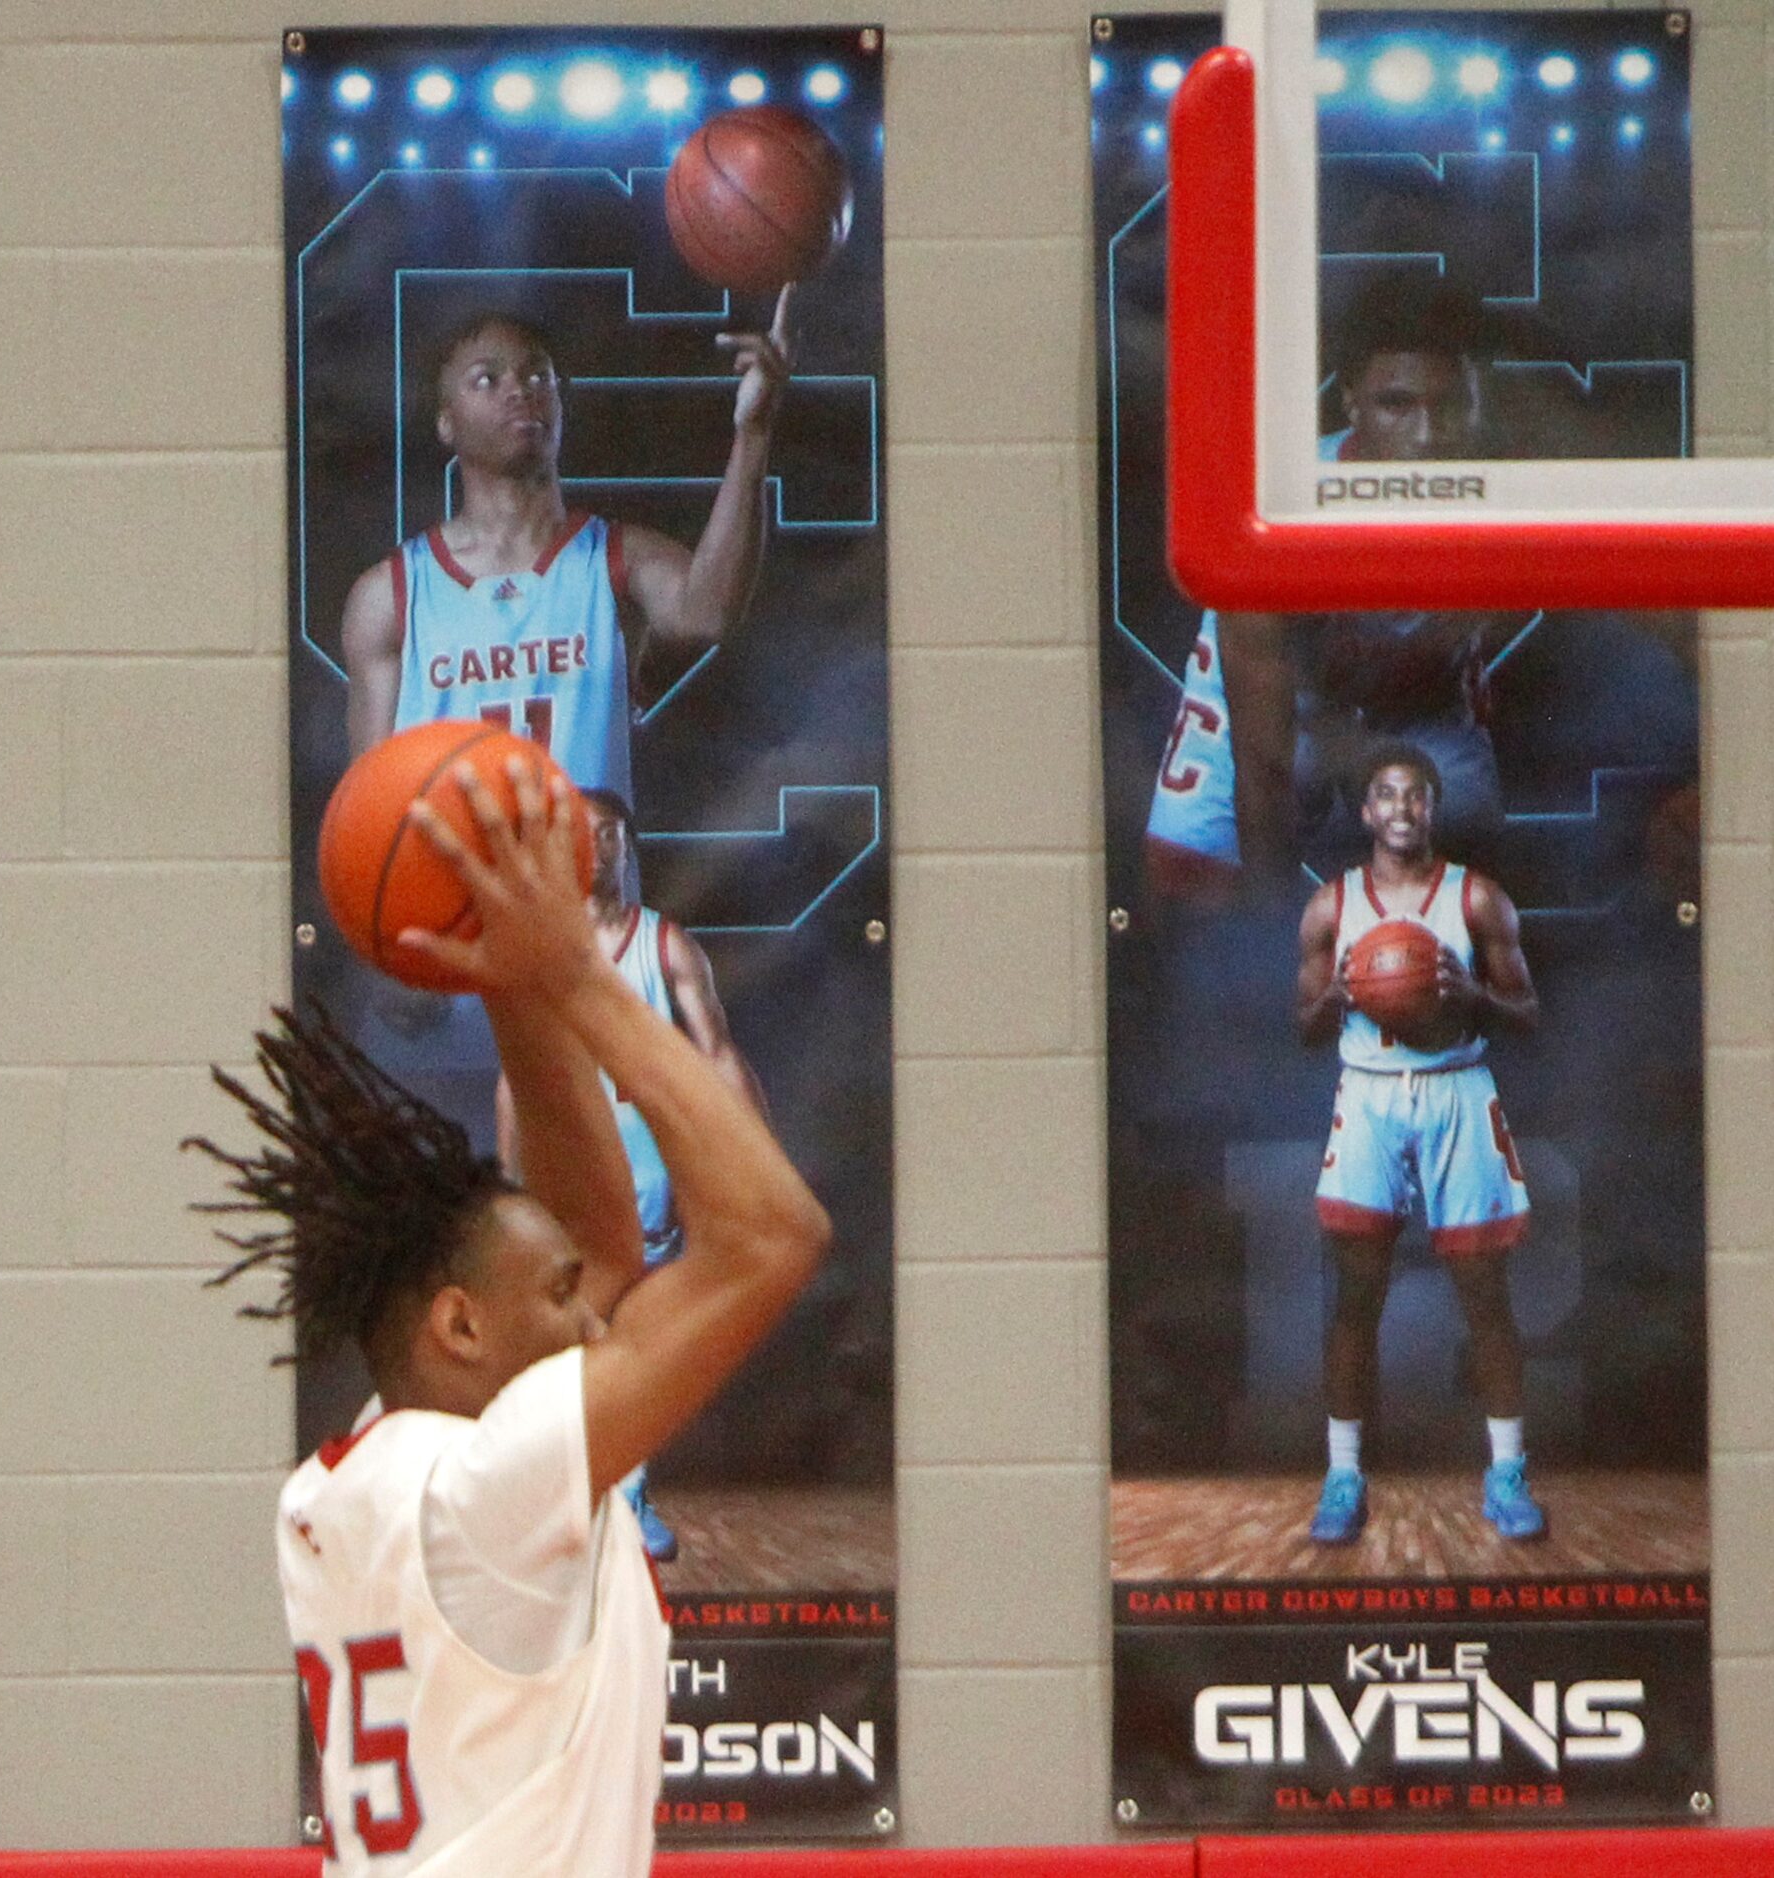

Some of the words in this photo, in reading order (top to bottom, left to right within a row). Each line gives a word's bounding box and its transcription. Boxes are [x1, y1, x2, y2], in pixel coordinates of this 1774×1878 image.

[1128, 1590, 1270, 1613] CARTER
[1281, 1586, 1458, 1611] COWBOYS
[1469, 1583, 1705, 1608] BASKETBALL
[1346, 1642, 1490, 1681] KYLE
[1193, 1672, 1647, 1772] GIVENS
[1274, 1787, 1394, 1810] CLASS
[1407, 1786, 1455, 1809] OF
[1469, 1784, 1566, 1809] 2023
